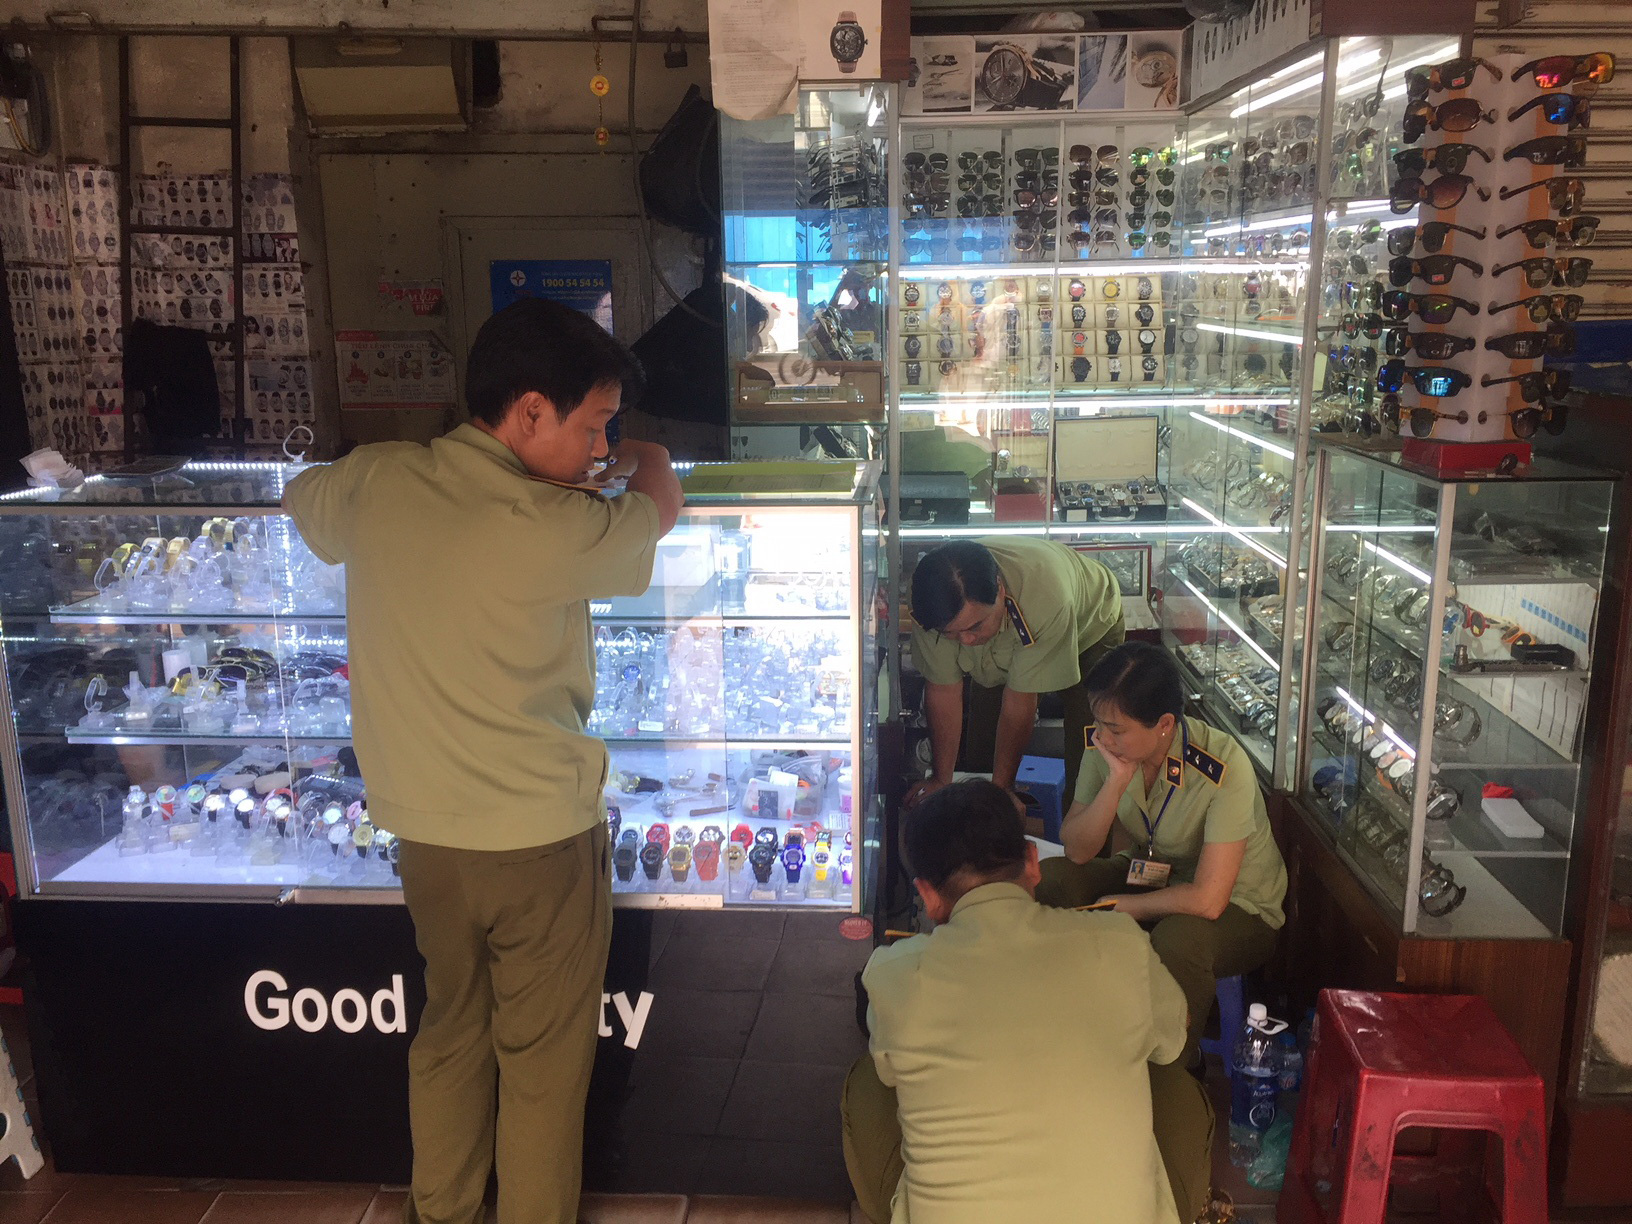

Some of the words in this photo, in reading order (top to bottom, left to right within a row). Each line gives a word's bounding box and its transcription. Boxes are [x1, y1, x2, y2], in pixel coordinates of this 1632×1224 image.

[542, 278, 564, 287] 1900
[566, 278, 578, 287] 54
[579, 278, 591, 287] 54
[592, 278, 605, 287] 54
[244, 969, 407, 1034] Good
